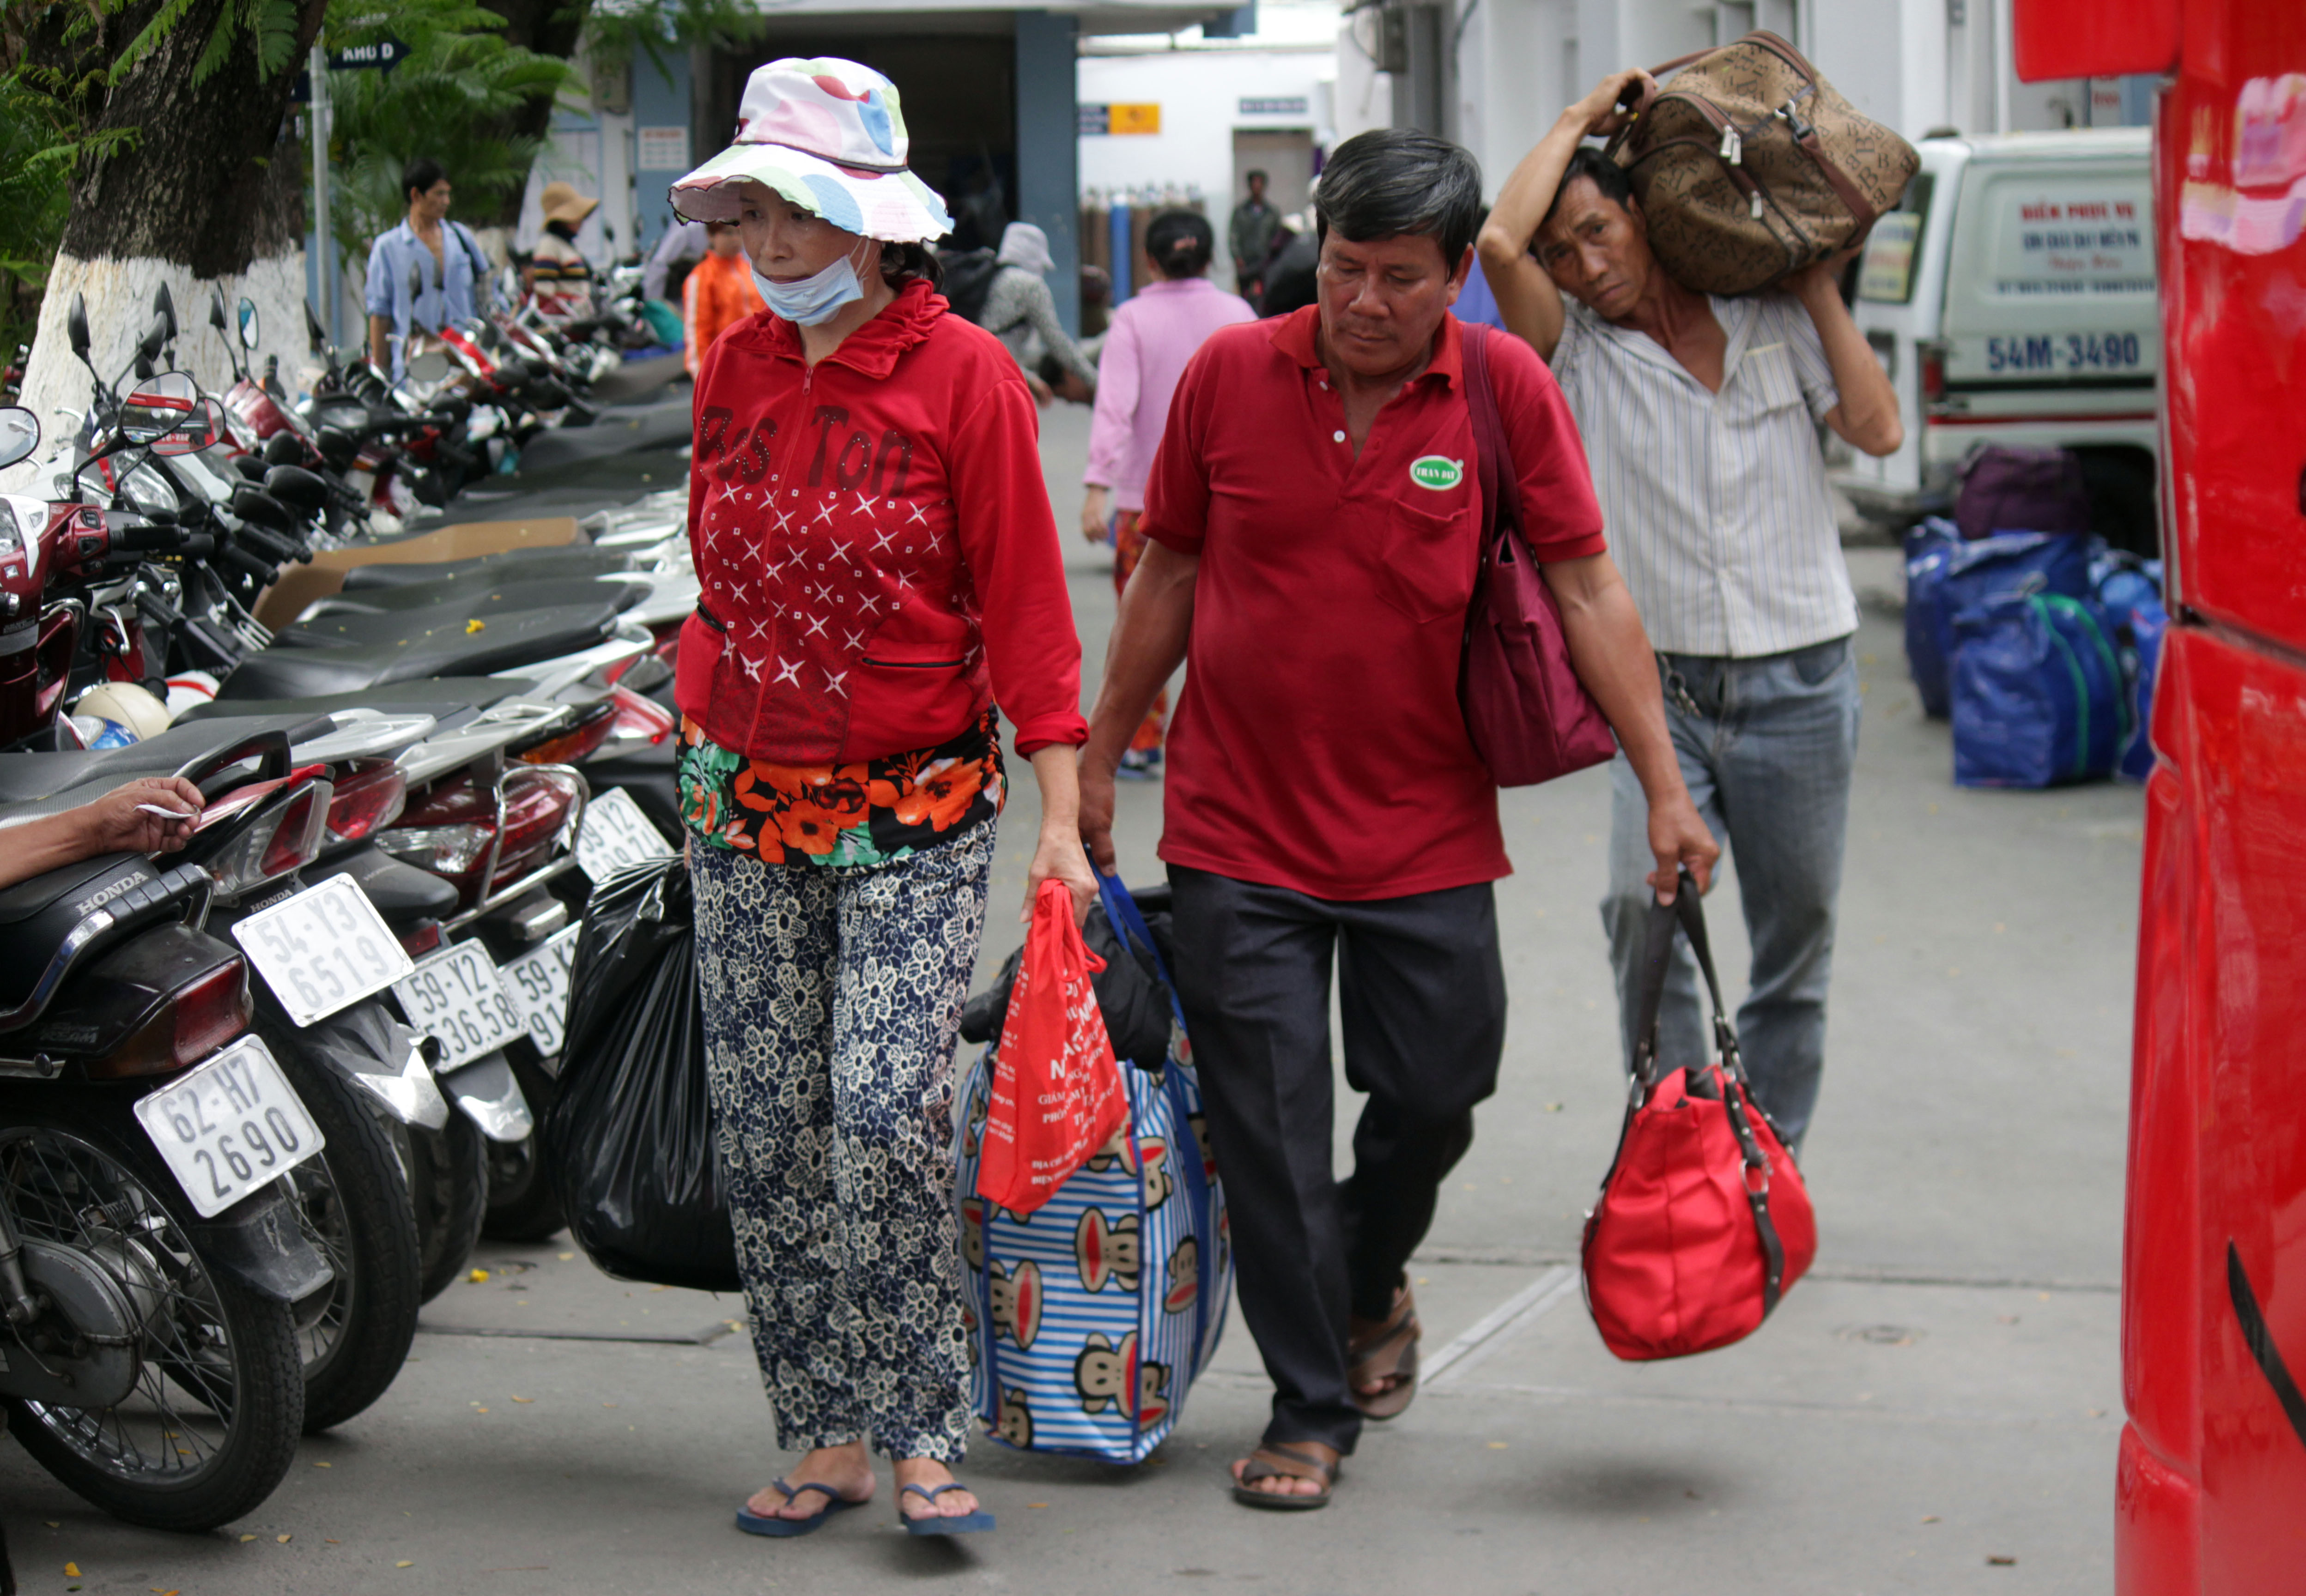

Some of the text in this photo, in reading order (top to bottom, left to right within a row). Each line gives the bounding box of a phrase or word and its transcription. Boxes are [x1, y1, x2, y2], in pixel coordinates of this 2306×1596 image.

[382, 42, 394, 59] D
[75, 871, 149, 916] HONDA
[250, 889, 293, 913] HONDA
[255, 892, 357, 963] 54-Y3
[288, 936, 389, 1008] 6519
[409, 954, 488, 1014] 59-Y2
[160, 1054, 261, 1143] 62-H7
[194, 1107, 299, 1198] 2690
